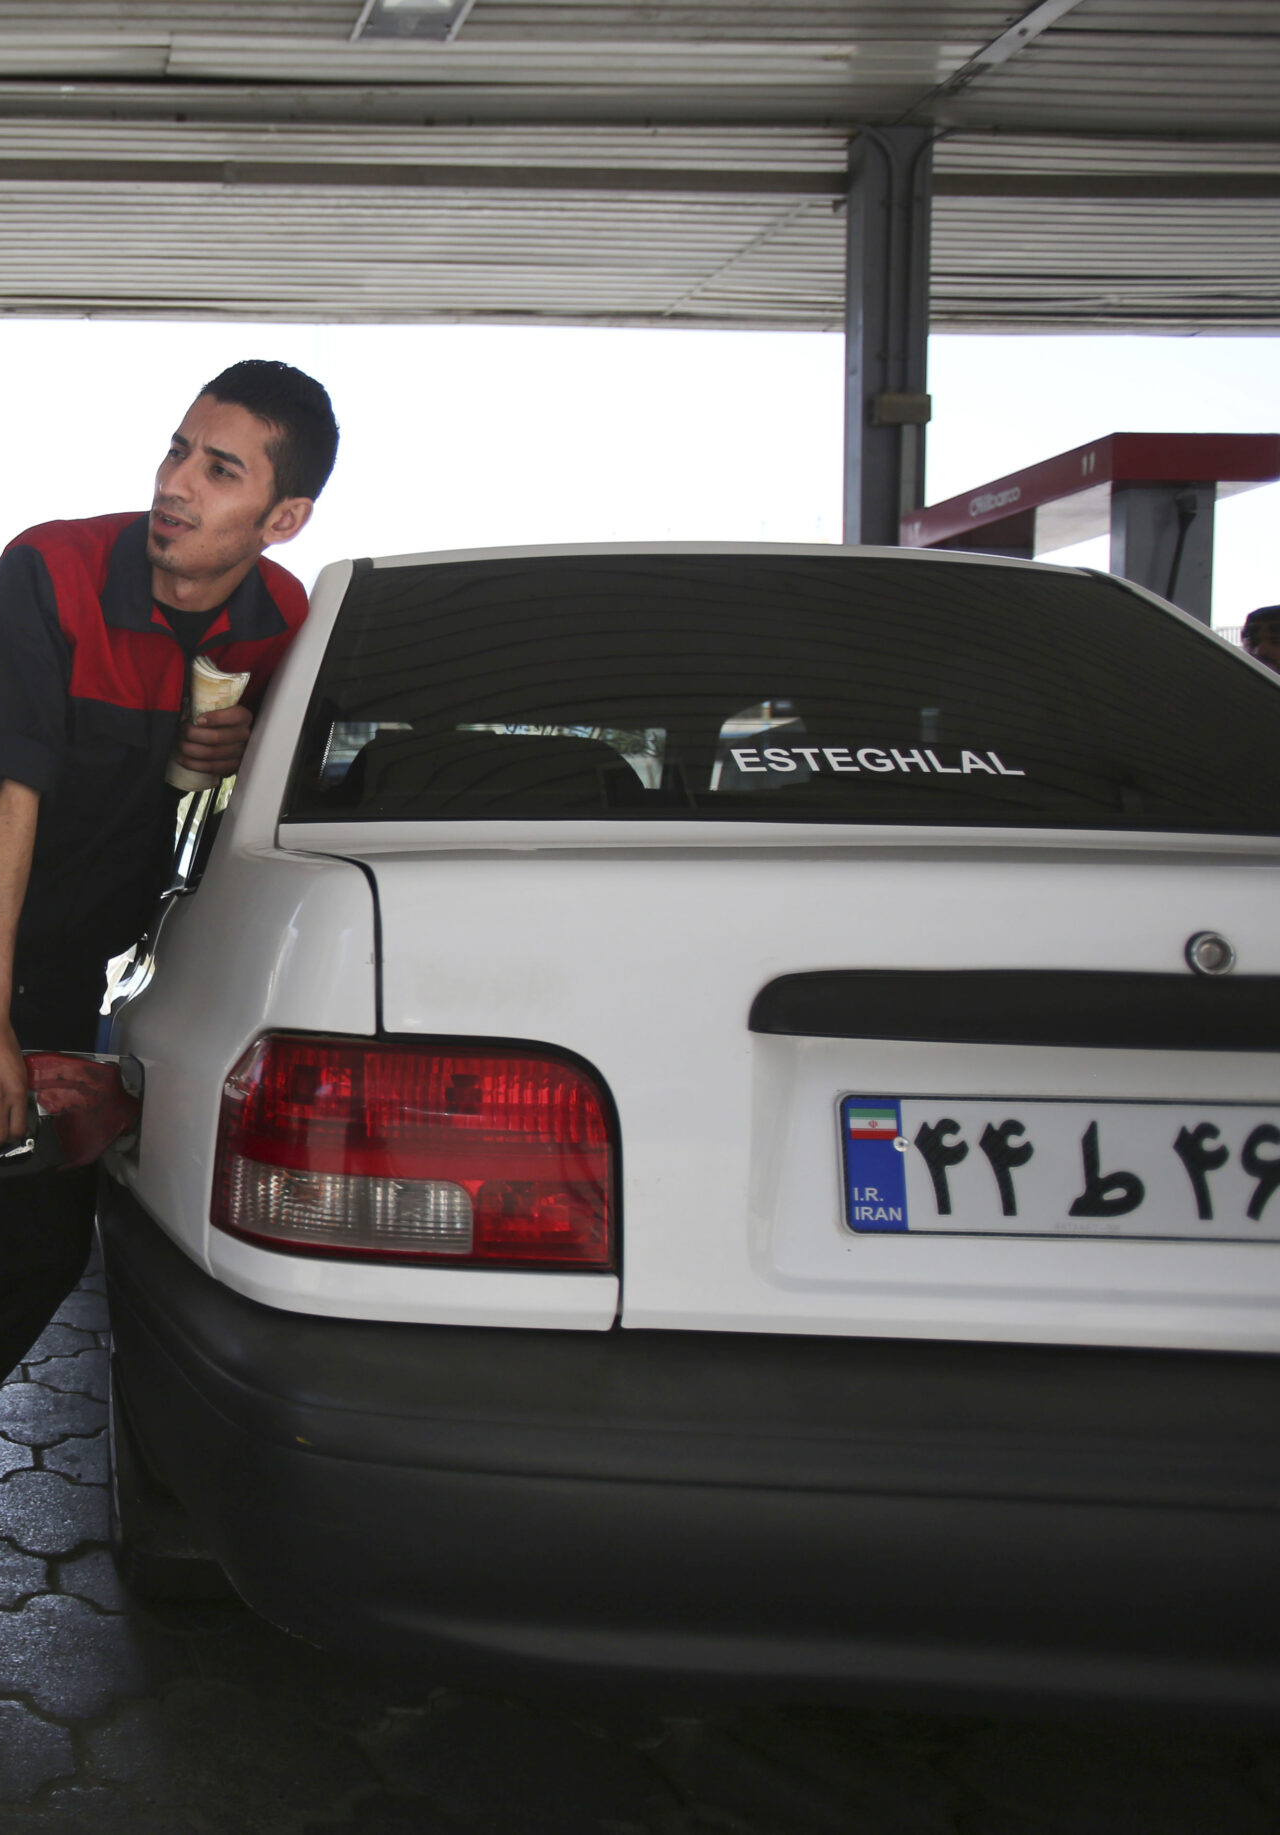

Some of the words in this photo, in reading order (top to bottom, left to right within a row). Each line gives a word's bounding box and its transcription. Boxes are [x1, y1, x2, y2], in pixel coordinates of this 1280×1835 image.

[730, 748, 1026, 776] ESTEGHLAL
[853, 1187, 884, 1201] I.R.
[854, 1206, 902, 1221] IRAN
